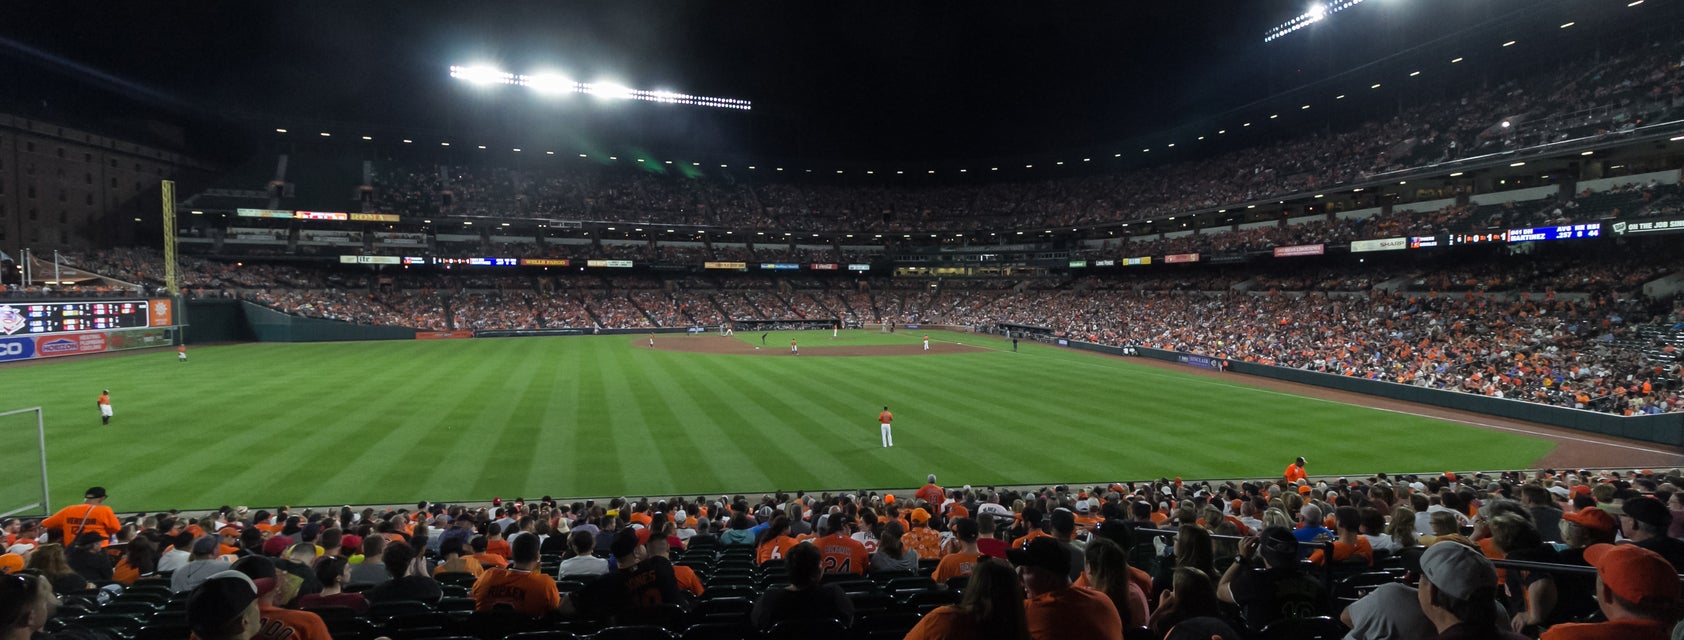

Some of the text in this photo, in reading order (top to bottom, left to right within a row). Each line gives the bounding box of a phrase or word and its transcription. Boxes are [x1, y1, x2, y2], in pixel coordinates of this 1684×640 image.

[1511, 233, 1545, 241] MARTINEZ
[771, 545, 782, 560] 6
[823, 555, 852, 574] 24
[488, 584, 526, 602] RIPKEN
